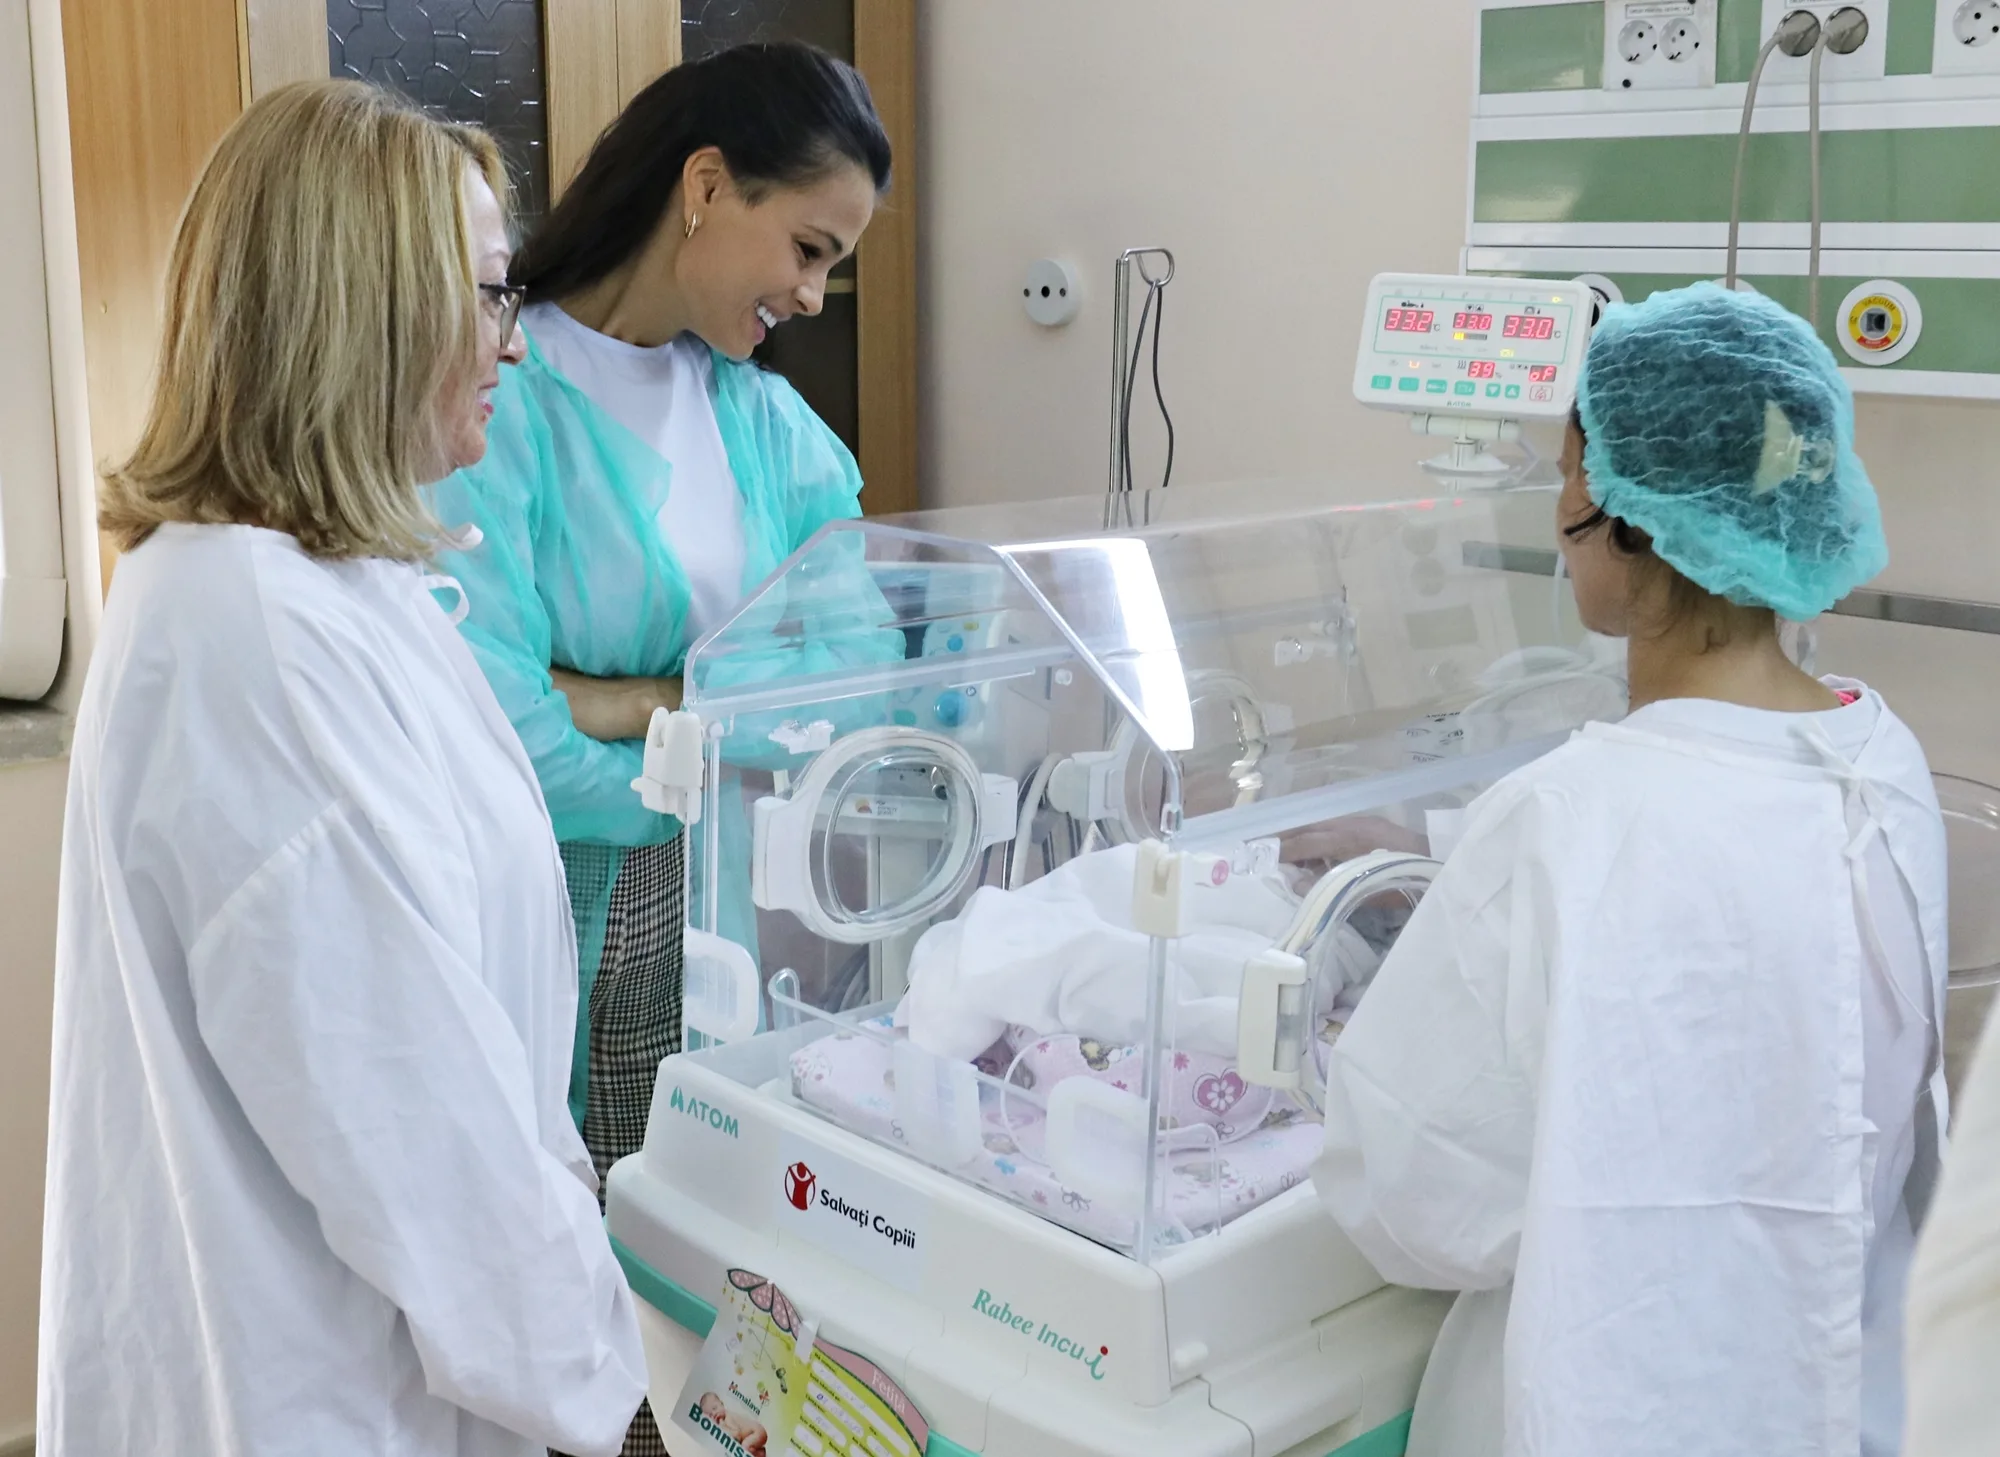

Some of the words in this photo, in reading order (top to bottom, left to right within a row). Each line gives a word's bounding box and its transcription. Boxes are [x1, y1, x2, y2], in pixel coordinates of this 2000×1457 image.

[1863, 296, 1897, 311] VACUUM
[1386, 310, 1432, 331] 33.2
[1454, 313, 1491, 329] 33.0
[1503, 316, 1552, 339] 33.0
[1469, 362, 1494, 377] 39
[687, 1097, 738, 1139] ATOM
[873, 1215, 916, 1249] Copiii
[972, 1288, 1034, 1335] Rabee
[728, 1381, 761, 1416] Himalaya
